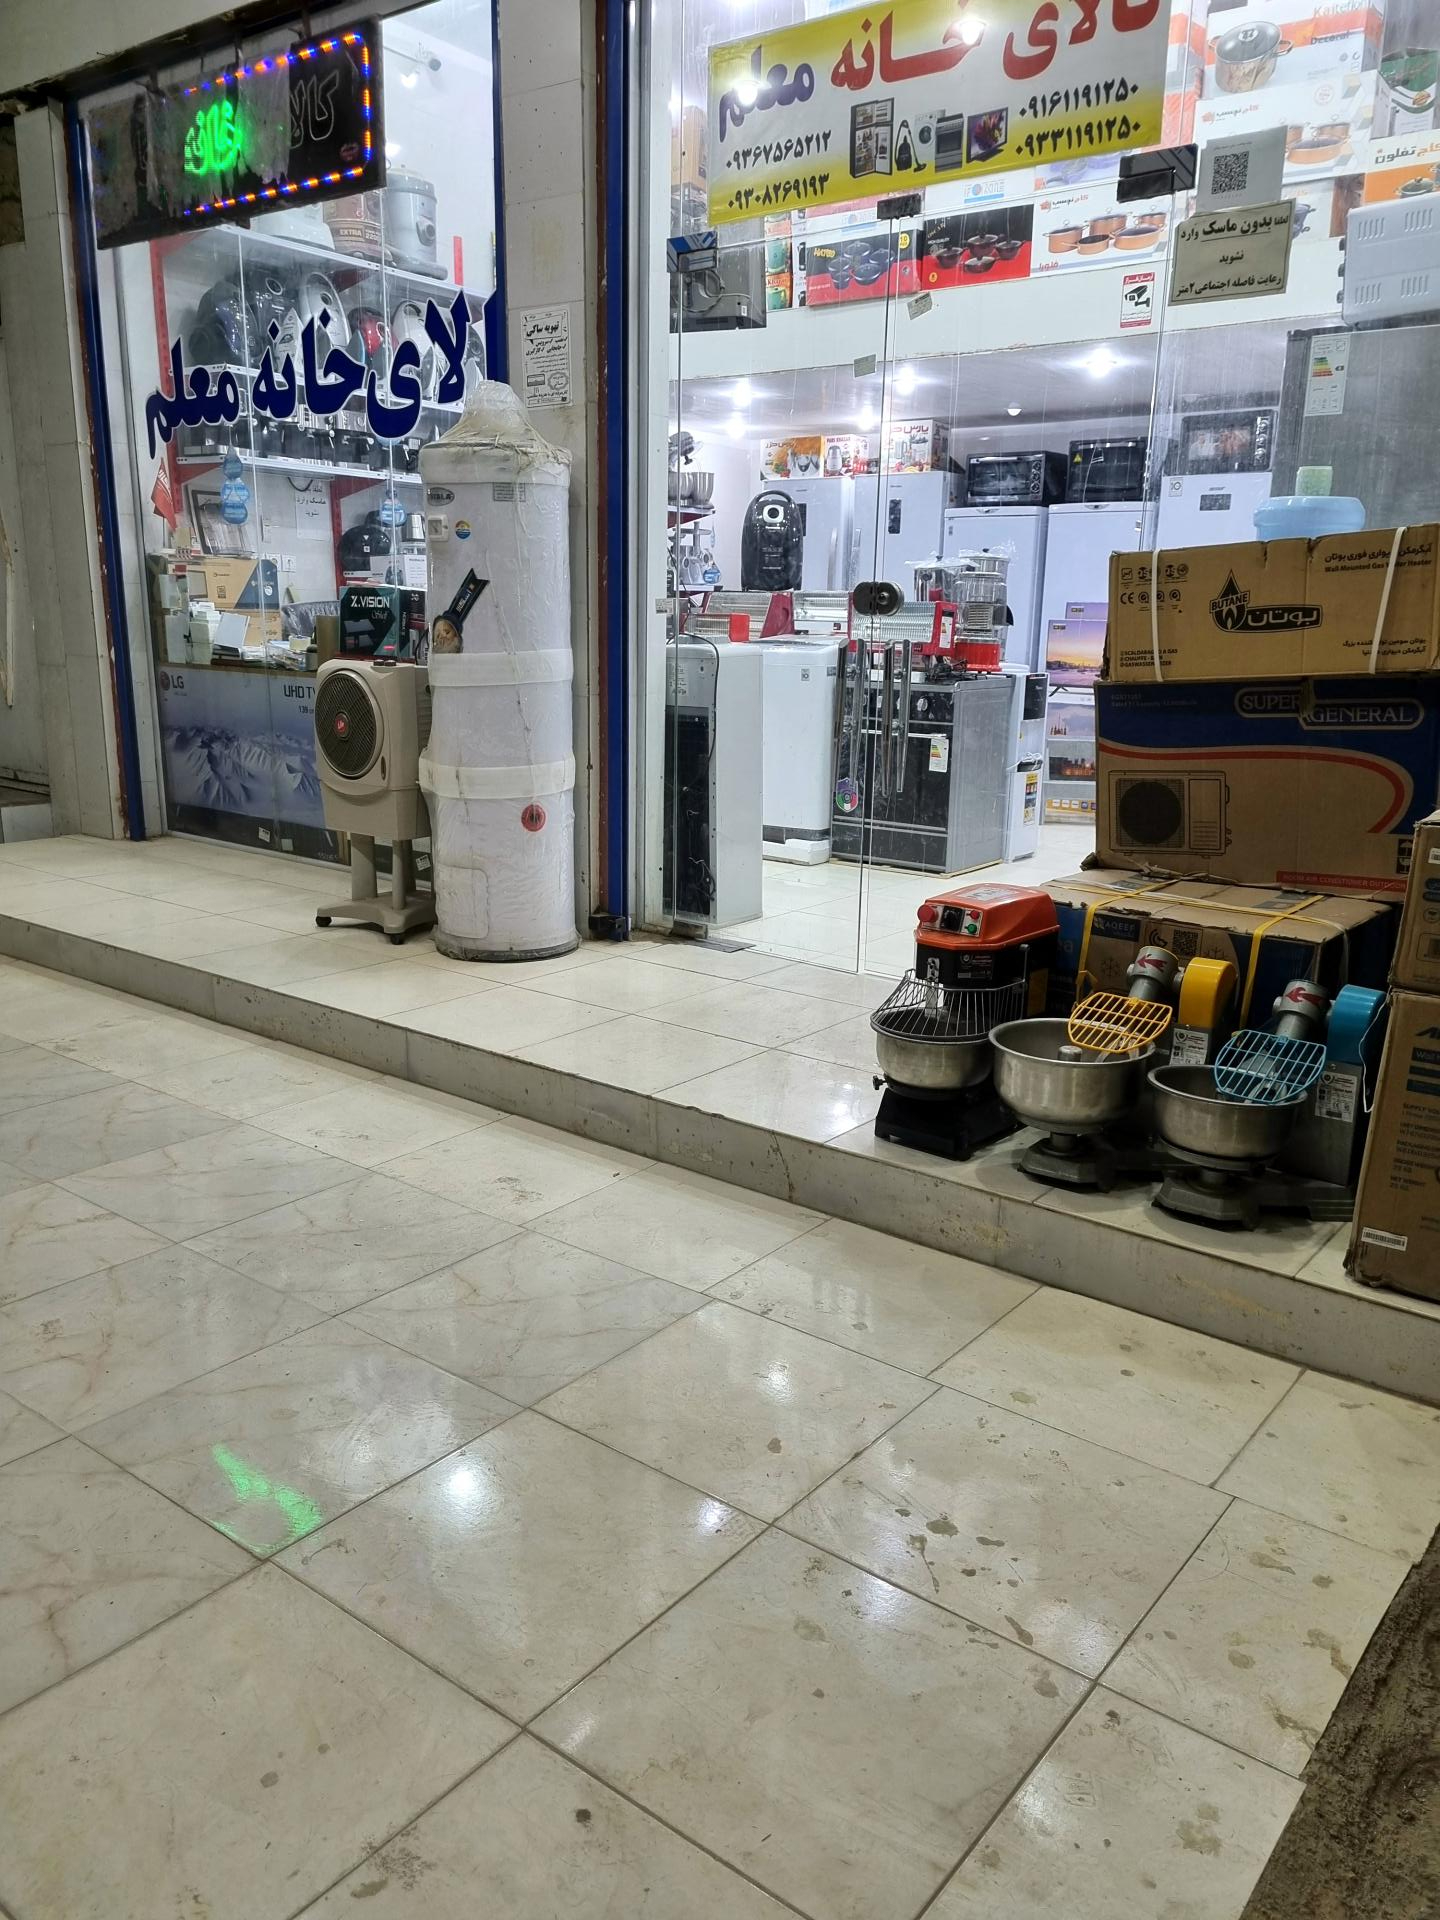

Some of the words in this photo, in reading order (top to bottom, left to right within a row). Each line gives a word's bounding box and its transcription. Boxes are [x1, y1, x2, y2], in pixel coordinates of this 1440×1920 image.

[830, 0, 987, 91] خانه
[719, 44, 815, 143] معلم
[1019, 77, 1139, 119] ۰۹۱۶۱۱۹۱۲۵۰
[1016, 115, 1141, 157] ۰۹۳۳۱۱۹۱۲۵۰
[726, 130, 832, 171] ۰۹۳۶۷۵۶۵۲۱۲
[728, 173, 830, 210] ۰۹۳۰۸۲۶۹۱۹۳
[1181, 226, 1199, 241] وارد
[1202, 218, 1237, 236] ماسک
[1240, 216, 1272, 234] بدون
[1219, 249, 1245, 265] نشوید
[1194, 278, 1230, 295] اجتماعی
[1232, 275, 1255, 288] فاصله
[1257, 274, 1283, 286] رعایت
[252, 307, 366, 419] خانه
[146, 337, 241, 460] معلم
[1324, 552, 1346, 563] بوتان
[1211, 592, 1249, 611] BUTANE
[1247, 609, 1318, 627] بوتان
[172, 676, 185, 690] LG
[283, 684, 305, 699] UHD
[1308, 706, 1413, 723] GENERAL
